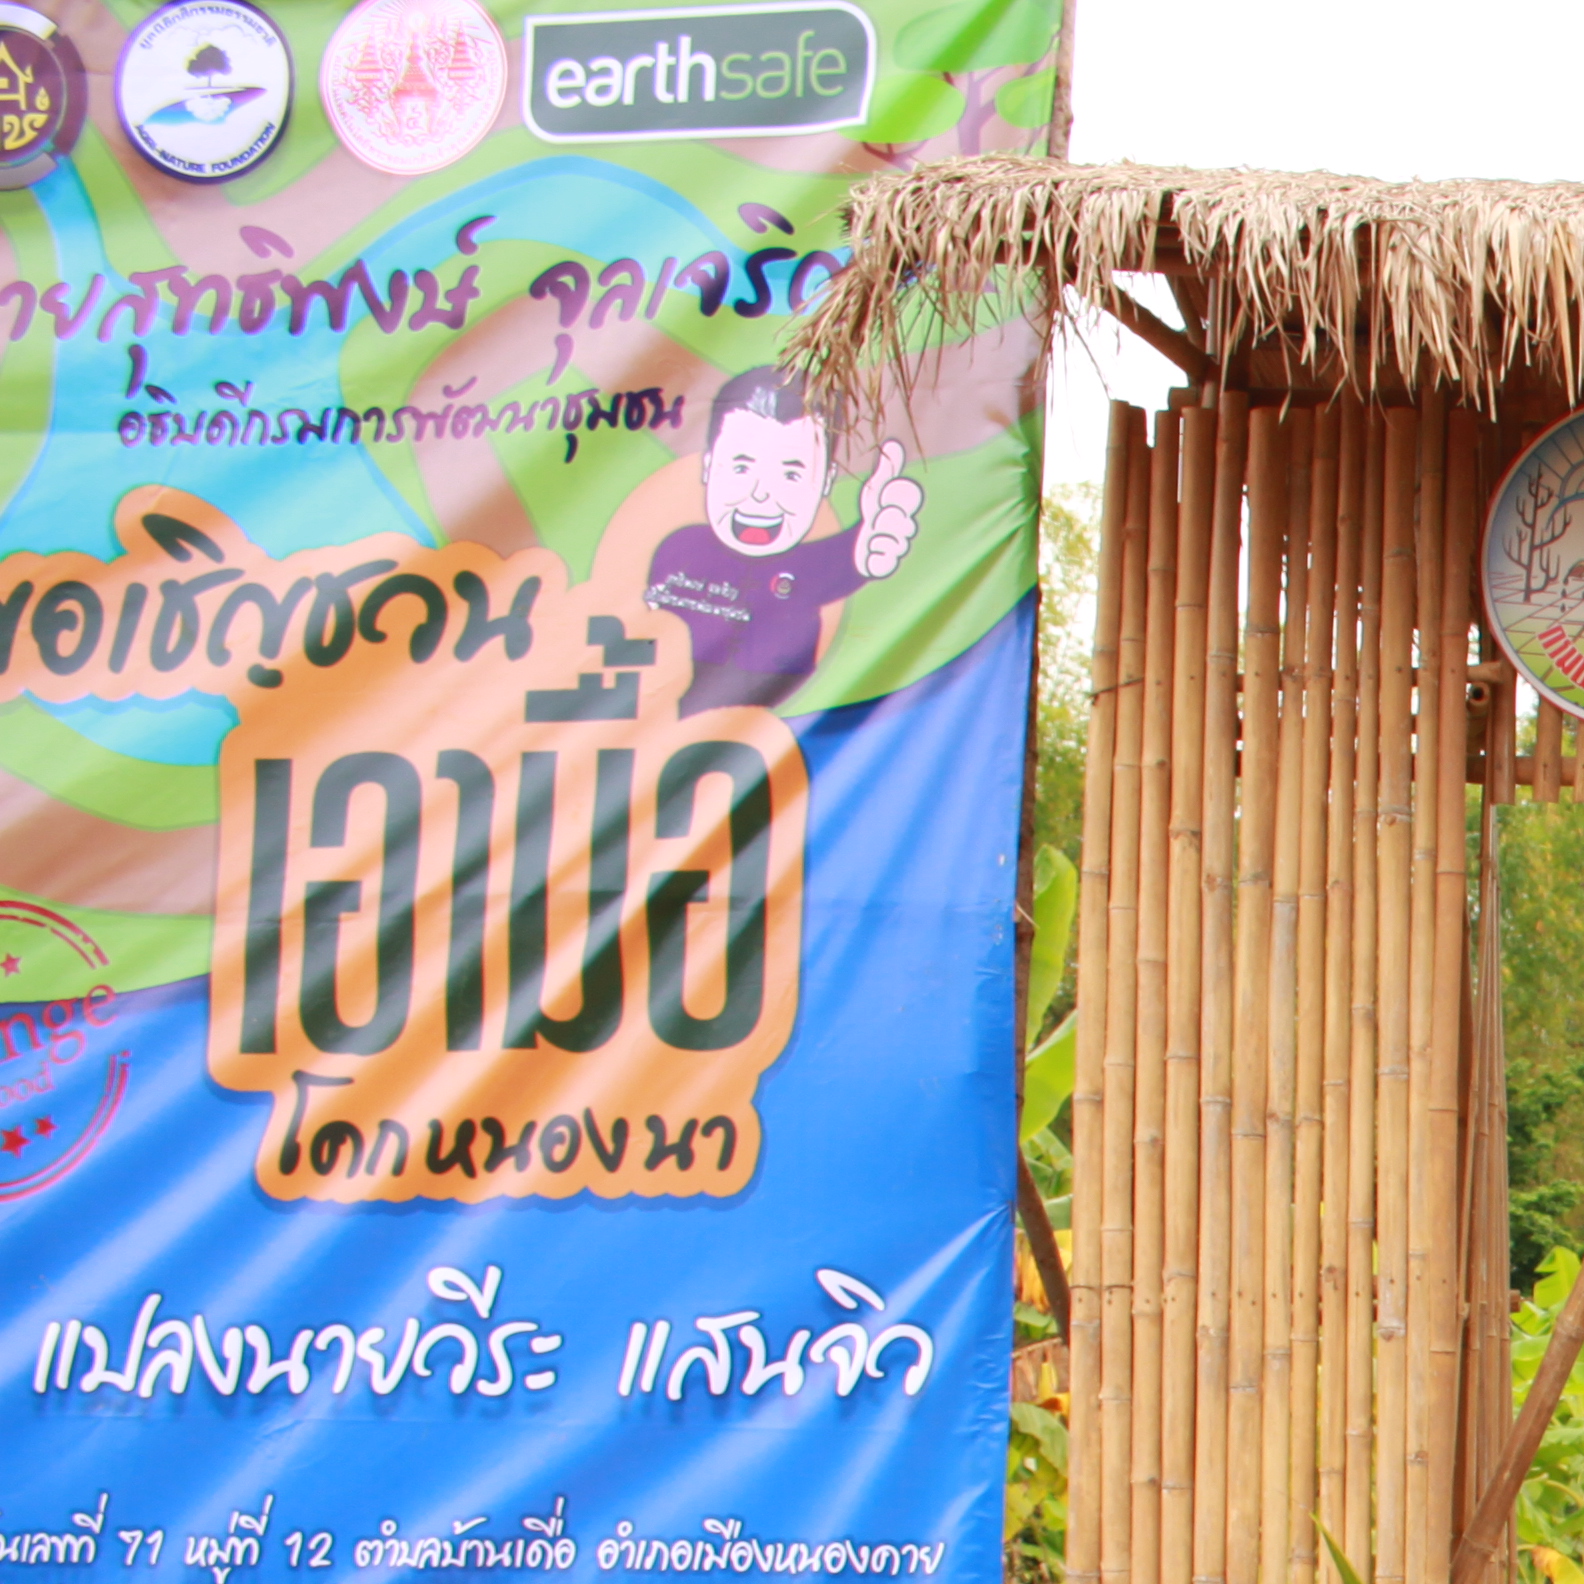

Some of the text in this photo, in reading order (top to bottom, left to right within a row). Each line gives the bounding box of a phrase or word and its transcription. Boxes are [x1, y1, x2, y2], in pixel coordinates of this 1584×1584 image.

[545, 30, 848, 109] earthsafe
[210, 121, 277, 174] FOUNDATION
[118, 376, 685, 464] อธิบดีกรมการพัฒนาชุมชน
[238, 614, 773, 1056] เอามื้อ
[34, 1265, 934, 1401] แปลงนายวีระ แสนจิว
[118, 1529, 164, 1565] 71
[284, 1531, 333, 1567] 12
[355, 1497, 576, 1570] ตำบลบ้านเดื่อ
[597, 1518, 945, 1575] อำเภอเมืองหนองคาย
